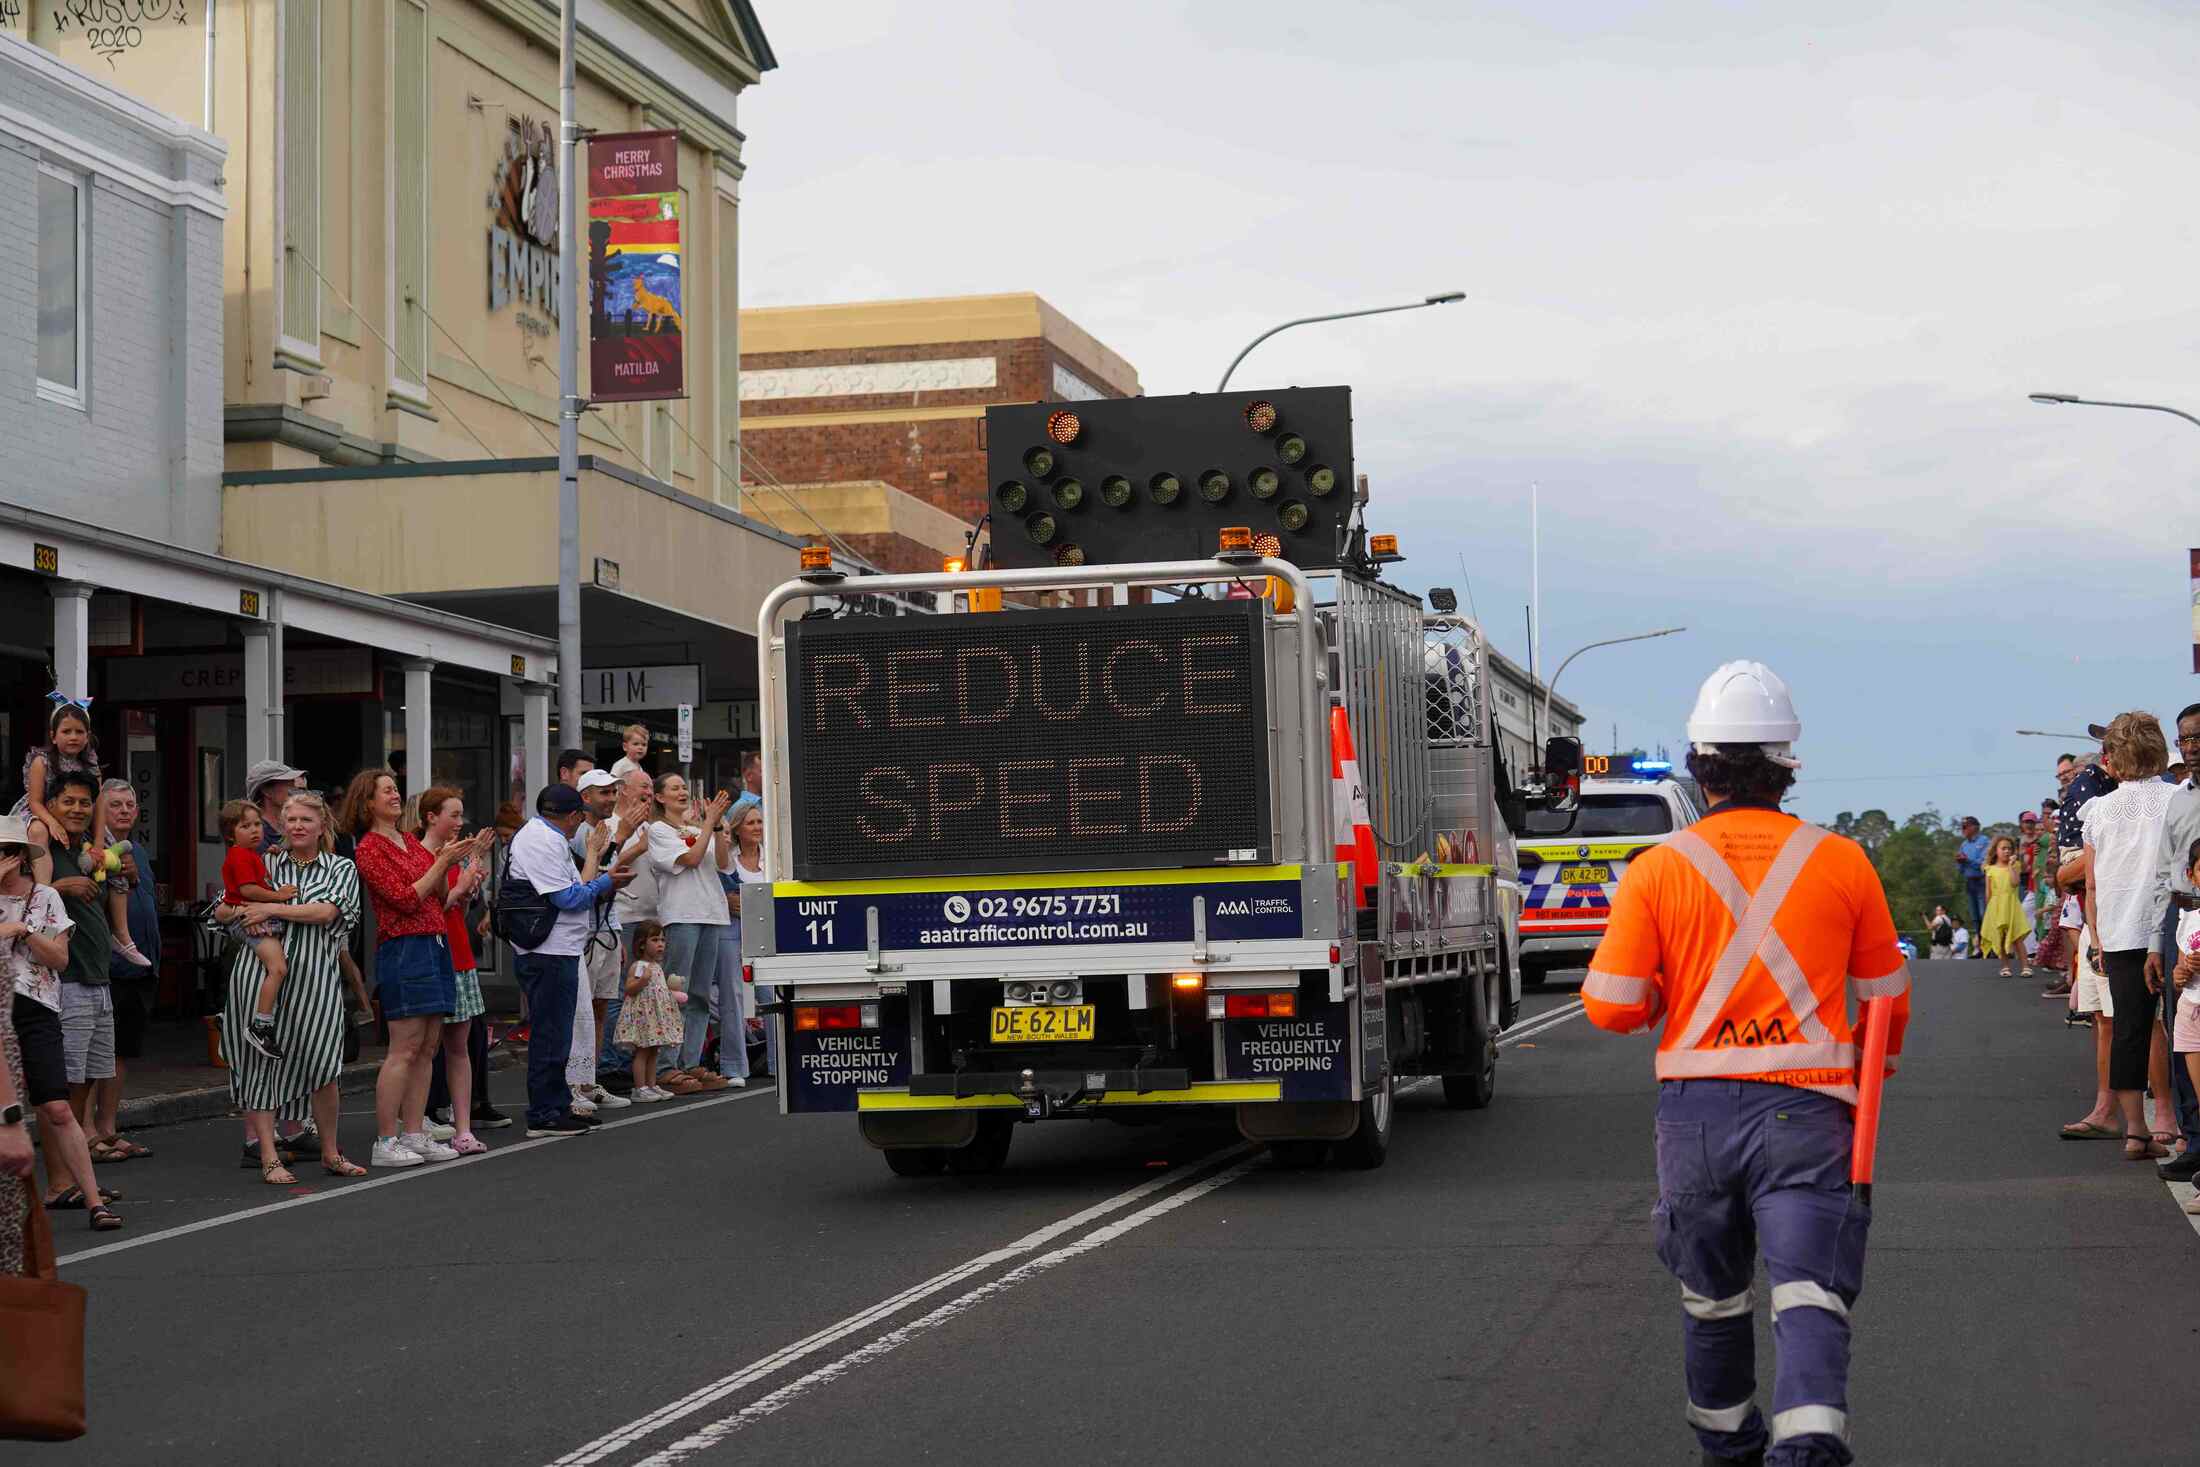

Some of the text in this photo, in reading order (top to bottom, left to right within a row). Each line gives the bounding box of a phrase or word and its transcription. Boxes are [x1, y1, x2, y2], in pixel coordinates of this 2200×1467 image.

[87, 26, 142, 49] 2020
[615, 150, 651, 162] MERRY
[604, 163, 663, 179] CHRISTMAS
[615, 362, 659, 377] MATILDA
[36, 548, 56, 571] 333
[242, 593, 257, 614] 331
[812, 635, 1244, 732] REDUCE
[856, 753, 1202, 843] SPEED
[1567, 889, 1605, 898] Police
[799, 900, 838, 916] UNIT
[977, 894, 1121, 917] 02 9675 7731
[1254, 898, 1289, 907] TRAFFIC
[1254, 906, 1294, 914] CONTROL
[805, 919, 834, 945] 11
[920, 921, 1148, 944] aaatrafficcontrol.com.au
[1026, 1033, 1051, 1041] SOUTH
[1258, 1022, 1324, 1038] VEHICLE
[817, 1036, 881, 1051] VEHICLE
[1241, 1039, 1342, 1055] FREQUENTLY
[801, 1052, 898, 1069] FREQUENTLY
[1253, 1056, 1332, 1072] STOPPING
[812, 1069, 888, 1085] STOPPING
